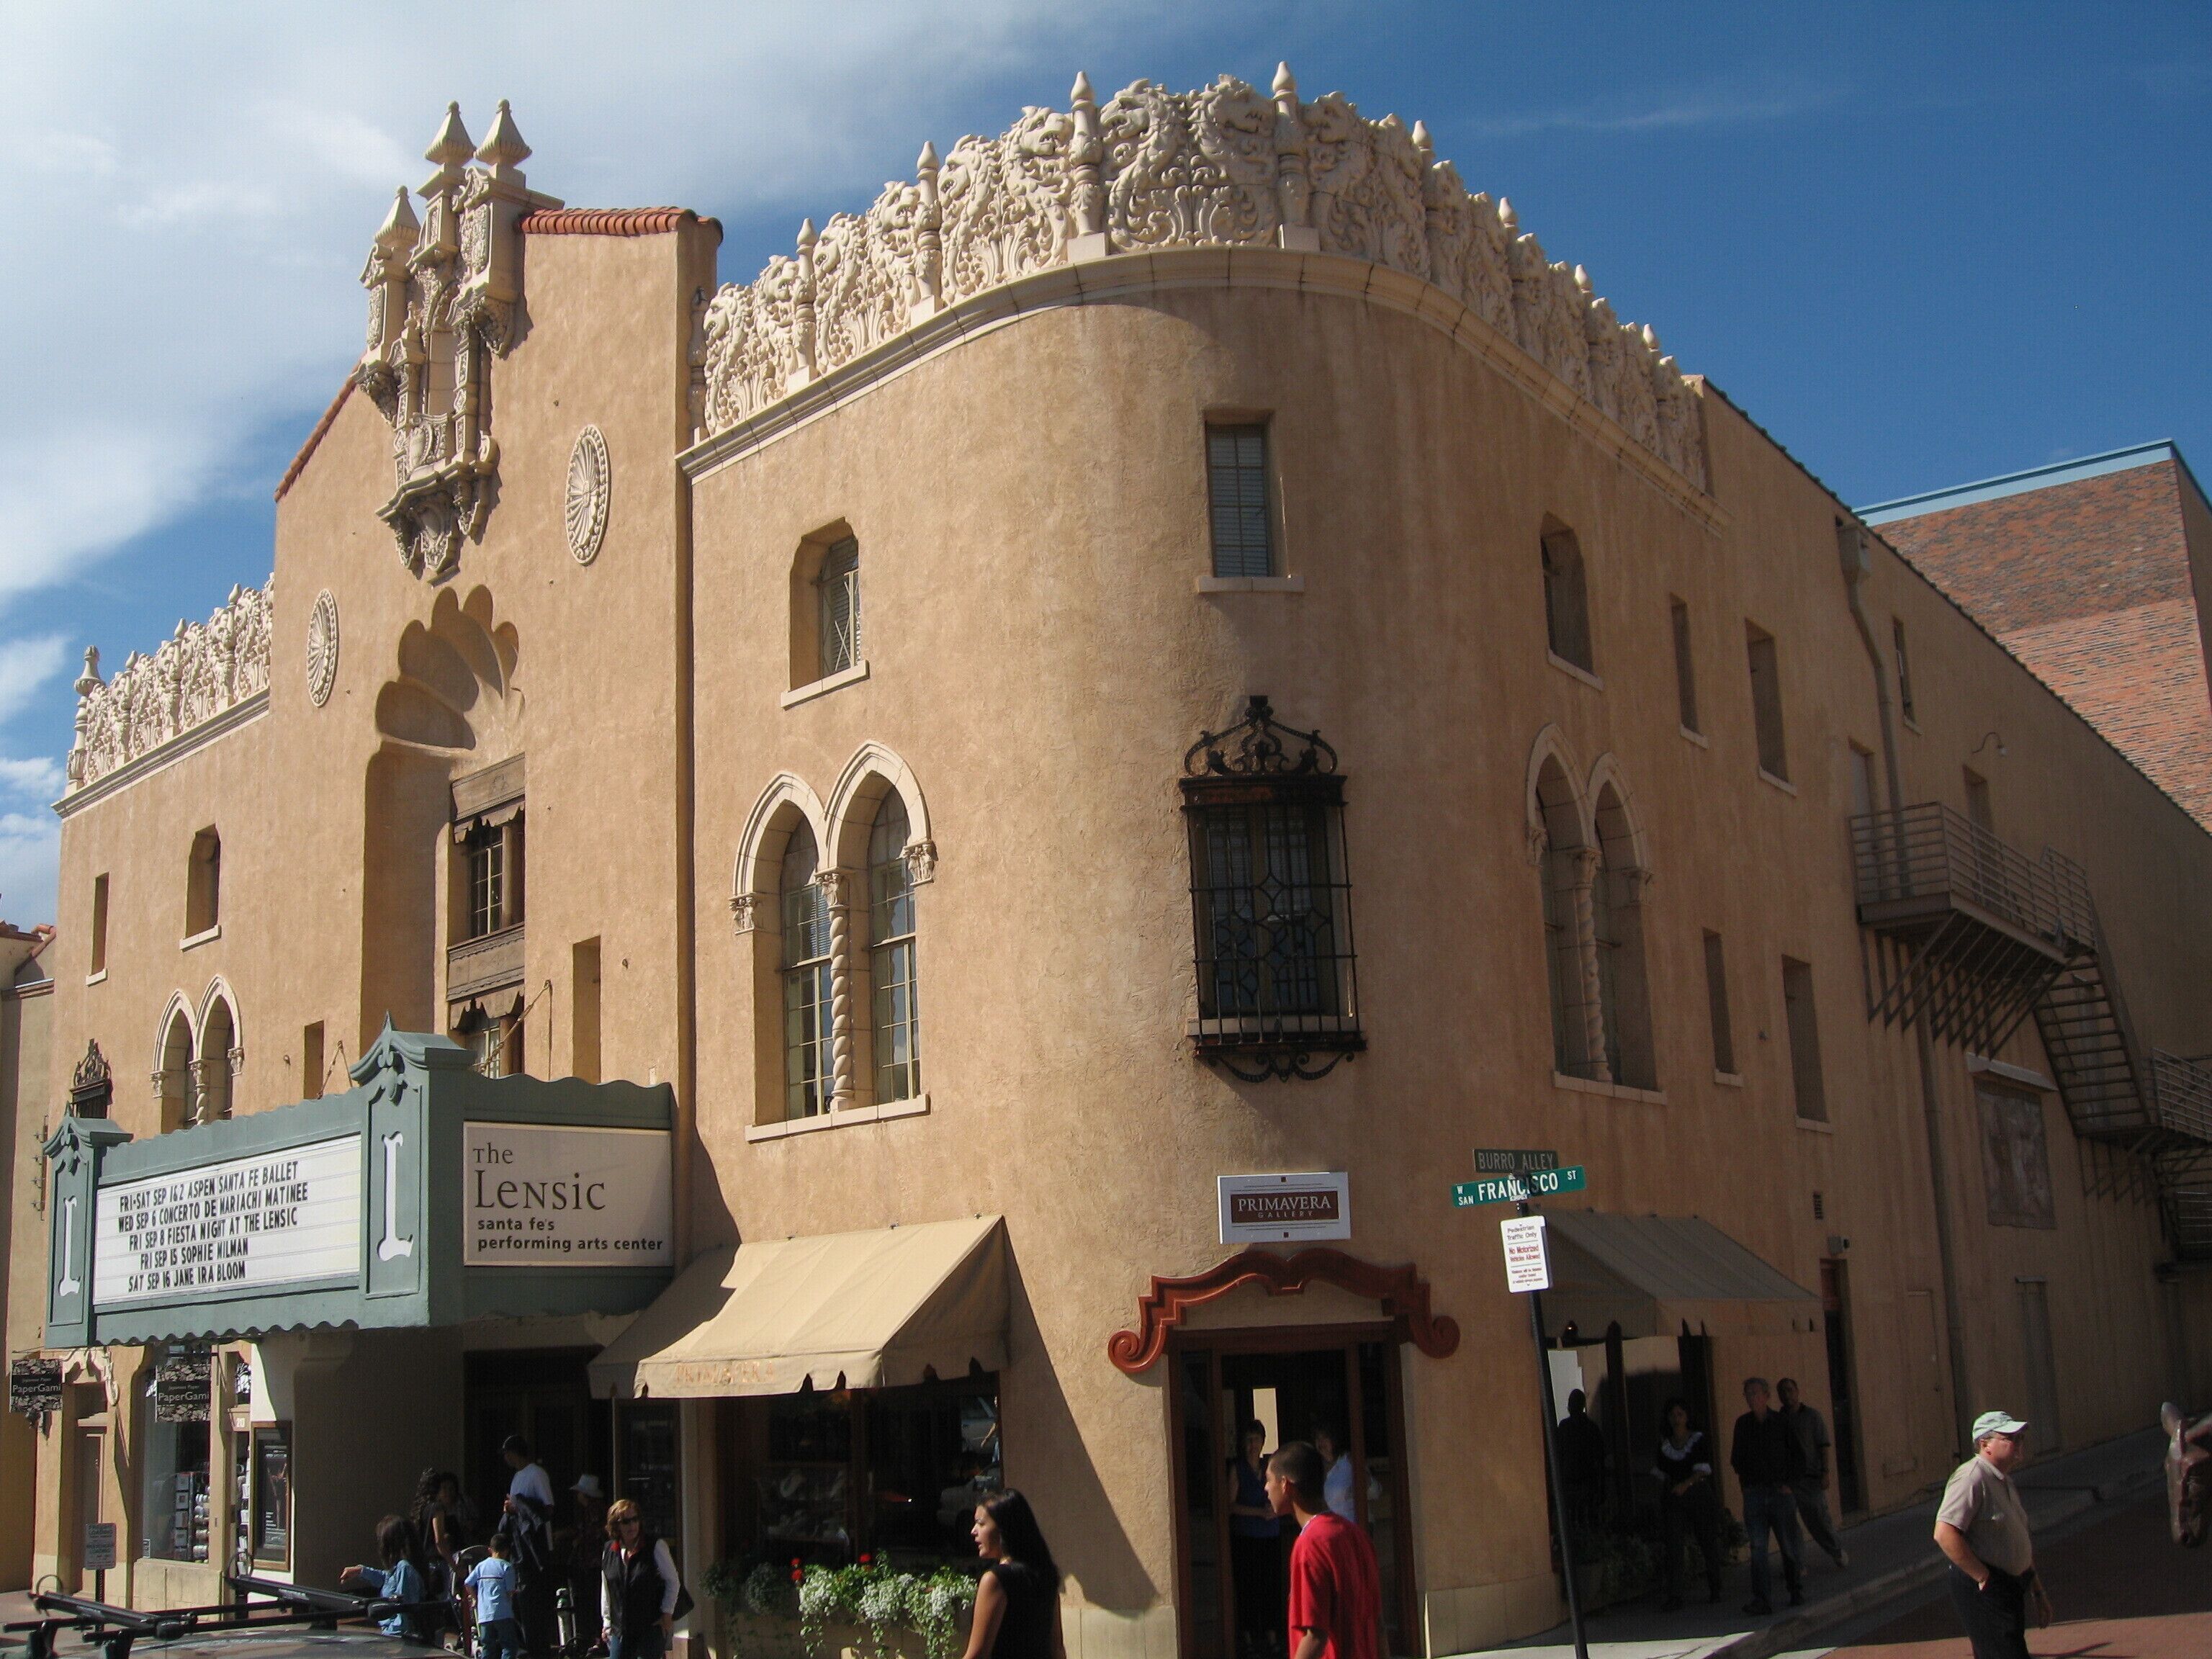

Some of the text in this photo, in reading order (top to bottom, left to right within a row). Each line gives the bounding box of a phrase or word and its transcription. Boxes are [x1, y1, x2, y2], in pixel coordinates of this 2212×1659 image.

[473, 1143, 513, 1164] The
[1478, 1152, 1553, 1170] BURRO ALLEY
[153, 1187, 166, 1206] SEP
[188, 1177, 215, 1199] ASPEN
[219, 1172, 245, 1194] SANTA
[248, 1168, 258, 1187] FE
[262, 1161, 298, 1185] BALLET
[1458, 1195, 1474, 1206] SAN
[1478, 1172, 1558, 1201] FRANCISCO
[1567, 1169, 1576, 1180] ST
[118, 1182, 309, 1233] WED SEP 6 CONCERTO DE MARIACHI MATINEE
[1238, 1195, 1331, 1212] PRIMAVERA
[129, 1207, 297, 1251] FRI SEP 8 FIESTA NIGHT AT THE LENSIC
[478, 1217, 554, 1231] santa fe's
[140, 1237, 248, 1270] FRI SEP 15 SOPHIE MILMAN
[478, 1236, 663, 1252] performing arts center
[128, 1260, 246, 1292] SAT SEP 16 JANE IRA BLOOM
[12, 1383, 61, 1395] PaperGami
